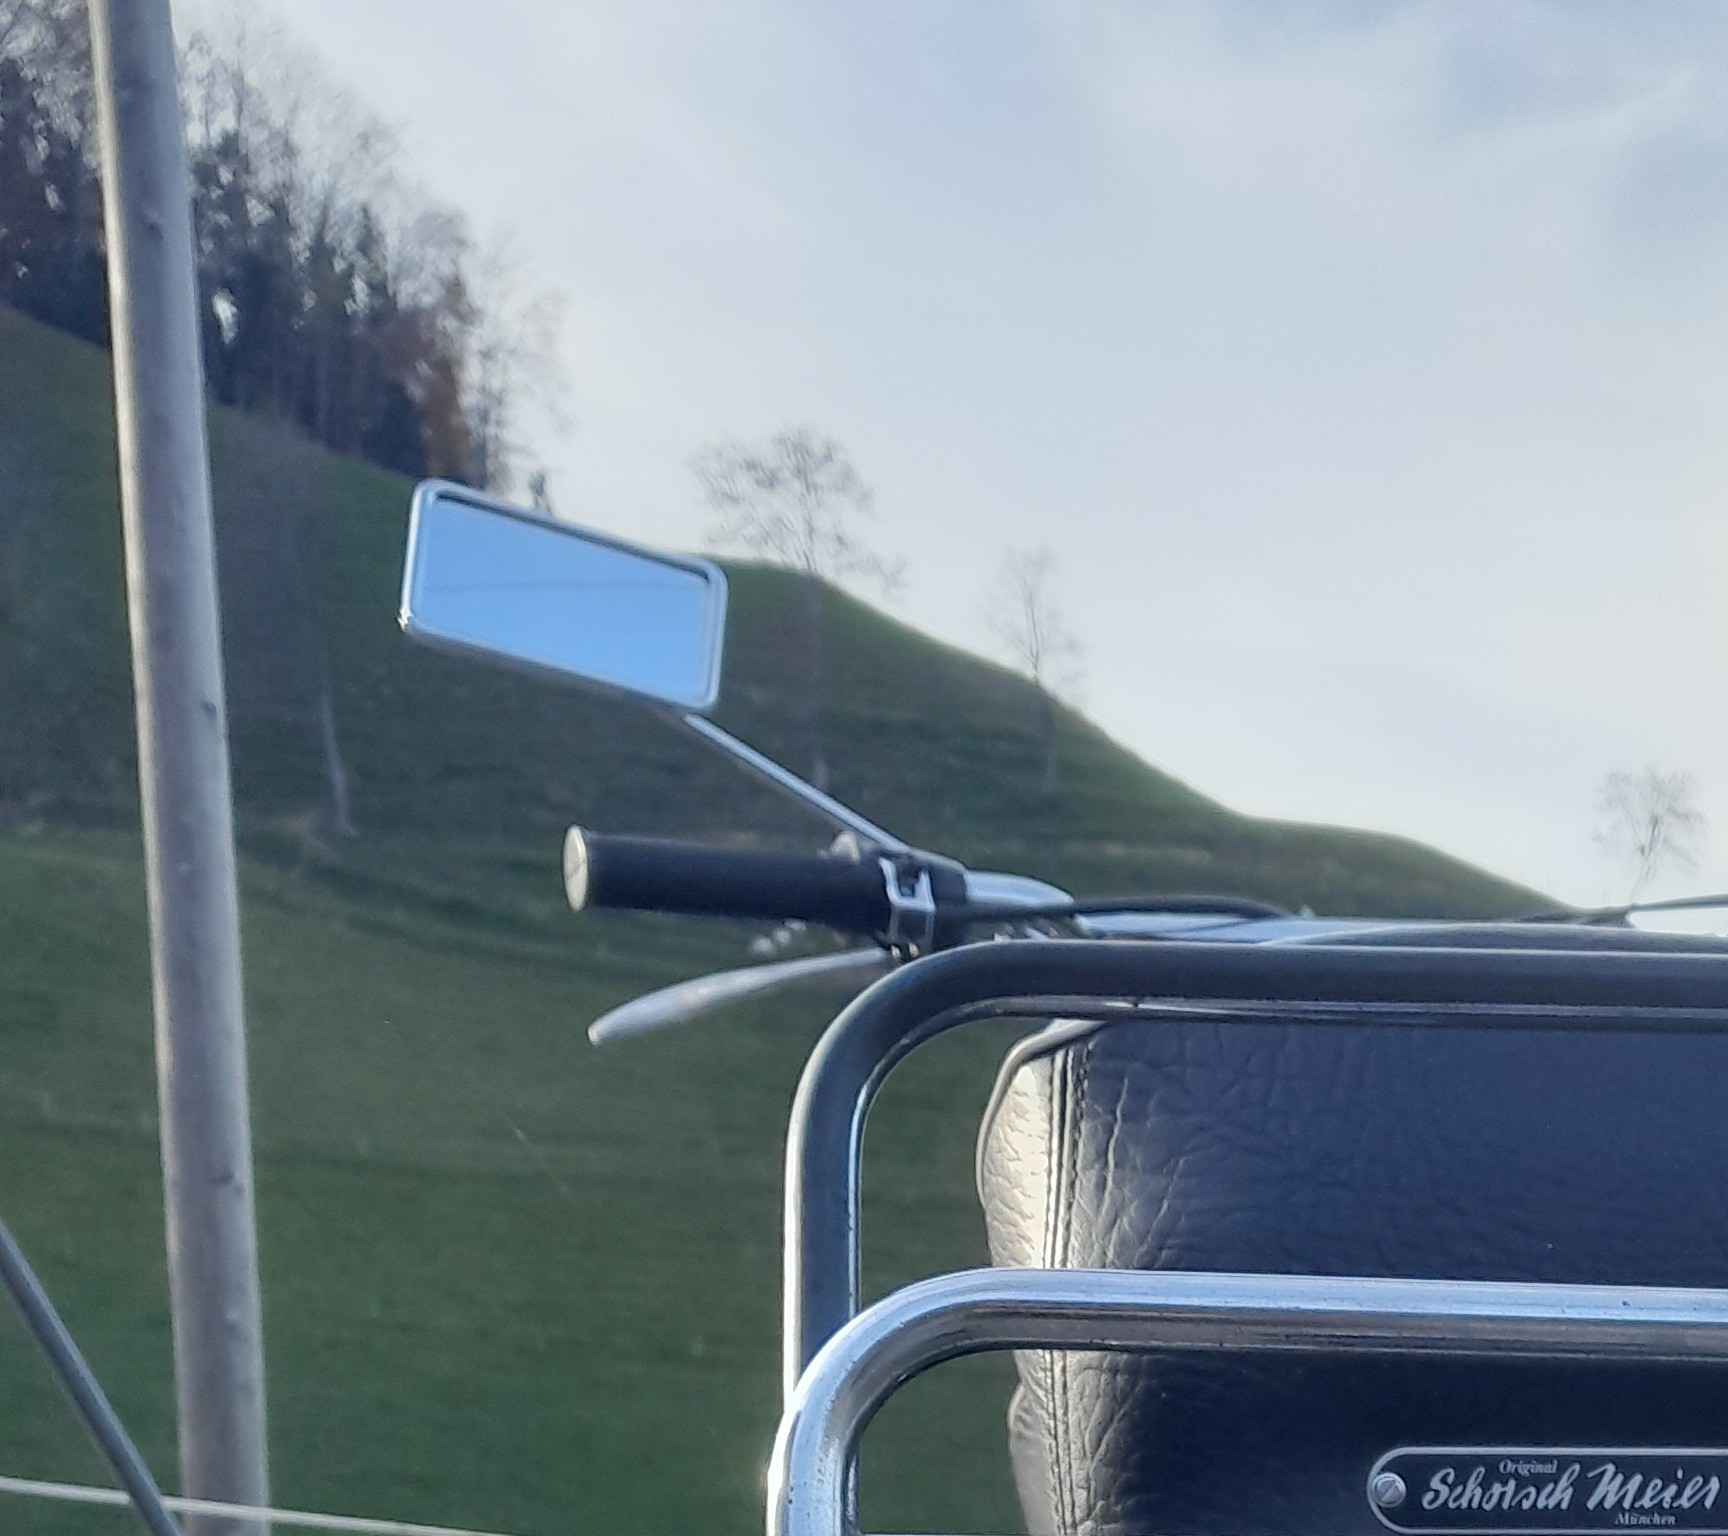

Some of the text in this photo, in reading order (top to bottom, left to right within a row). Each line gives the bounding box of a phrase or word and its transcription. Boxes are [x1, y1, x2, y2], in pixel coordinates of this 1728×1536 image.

[1498, 1459, 1558, 1477] Original
[1585, 1462, 1720, 1511] Meier
[1613, 1511, 1677, 1526] München
